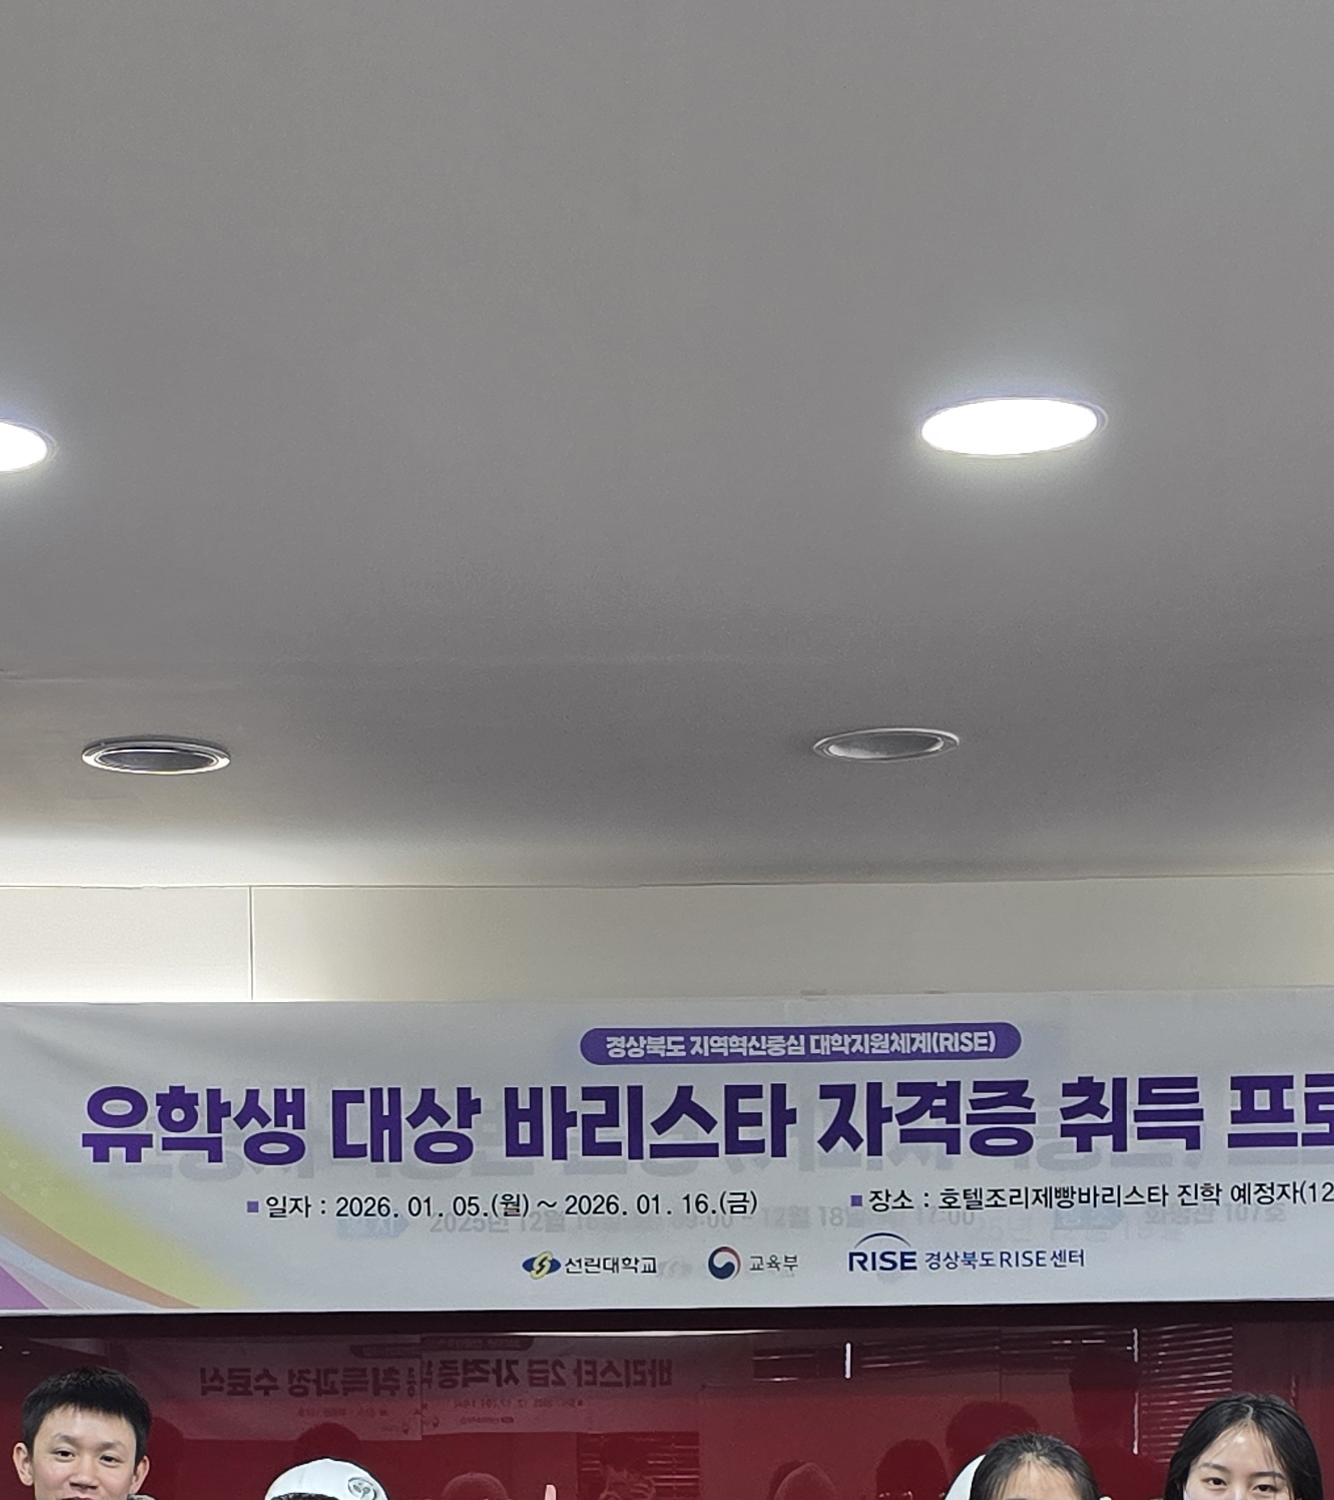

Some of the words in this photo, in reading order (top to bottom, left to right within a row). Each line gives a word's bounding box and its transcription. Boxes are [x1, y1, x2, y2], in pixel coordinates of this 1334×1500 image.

[607, 1036, 686, 1057] 경상북도
[690, 1035, 805, 1056] 지역혁신중심
[810, 1031, 996, 1055] 대학지원체계(RISE)
[82, 1086, 305, 1165] 유학생
[332, 1087, 481, 1164] 대상
[504, 1083, 797, 1160] 바리스타
[816, 1079, 1036, 1157] 자격증
[1060, 1076, 1204, 1153] 취득
[266, 1196, 311, 1218] 일자
[336, 1197, 398, 1218] 2026.
[408, 1197, 443, 1217] 01.
[453, 1194, 528, 1217] 05.(월)
[565, 1194, 627, 1215] 2026.
[637, 1194, 671, 1214] 01.
[683, 1191, 757, 1214] 16.(금)
[869, 1189, 914, 1212] 장소
[939, 1184, 1169, 1210] 호텔조리제빵바리스타
[1178, 1183, 1222, 1206] 진학
[565, 1257, 656, 1273] 선린대학교
[750, 1255, 797, 1271] 교육부
[849, 1251, 917, 1271] RISE
